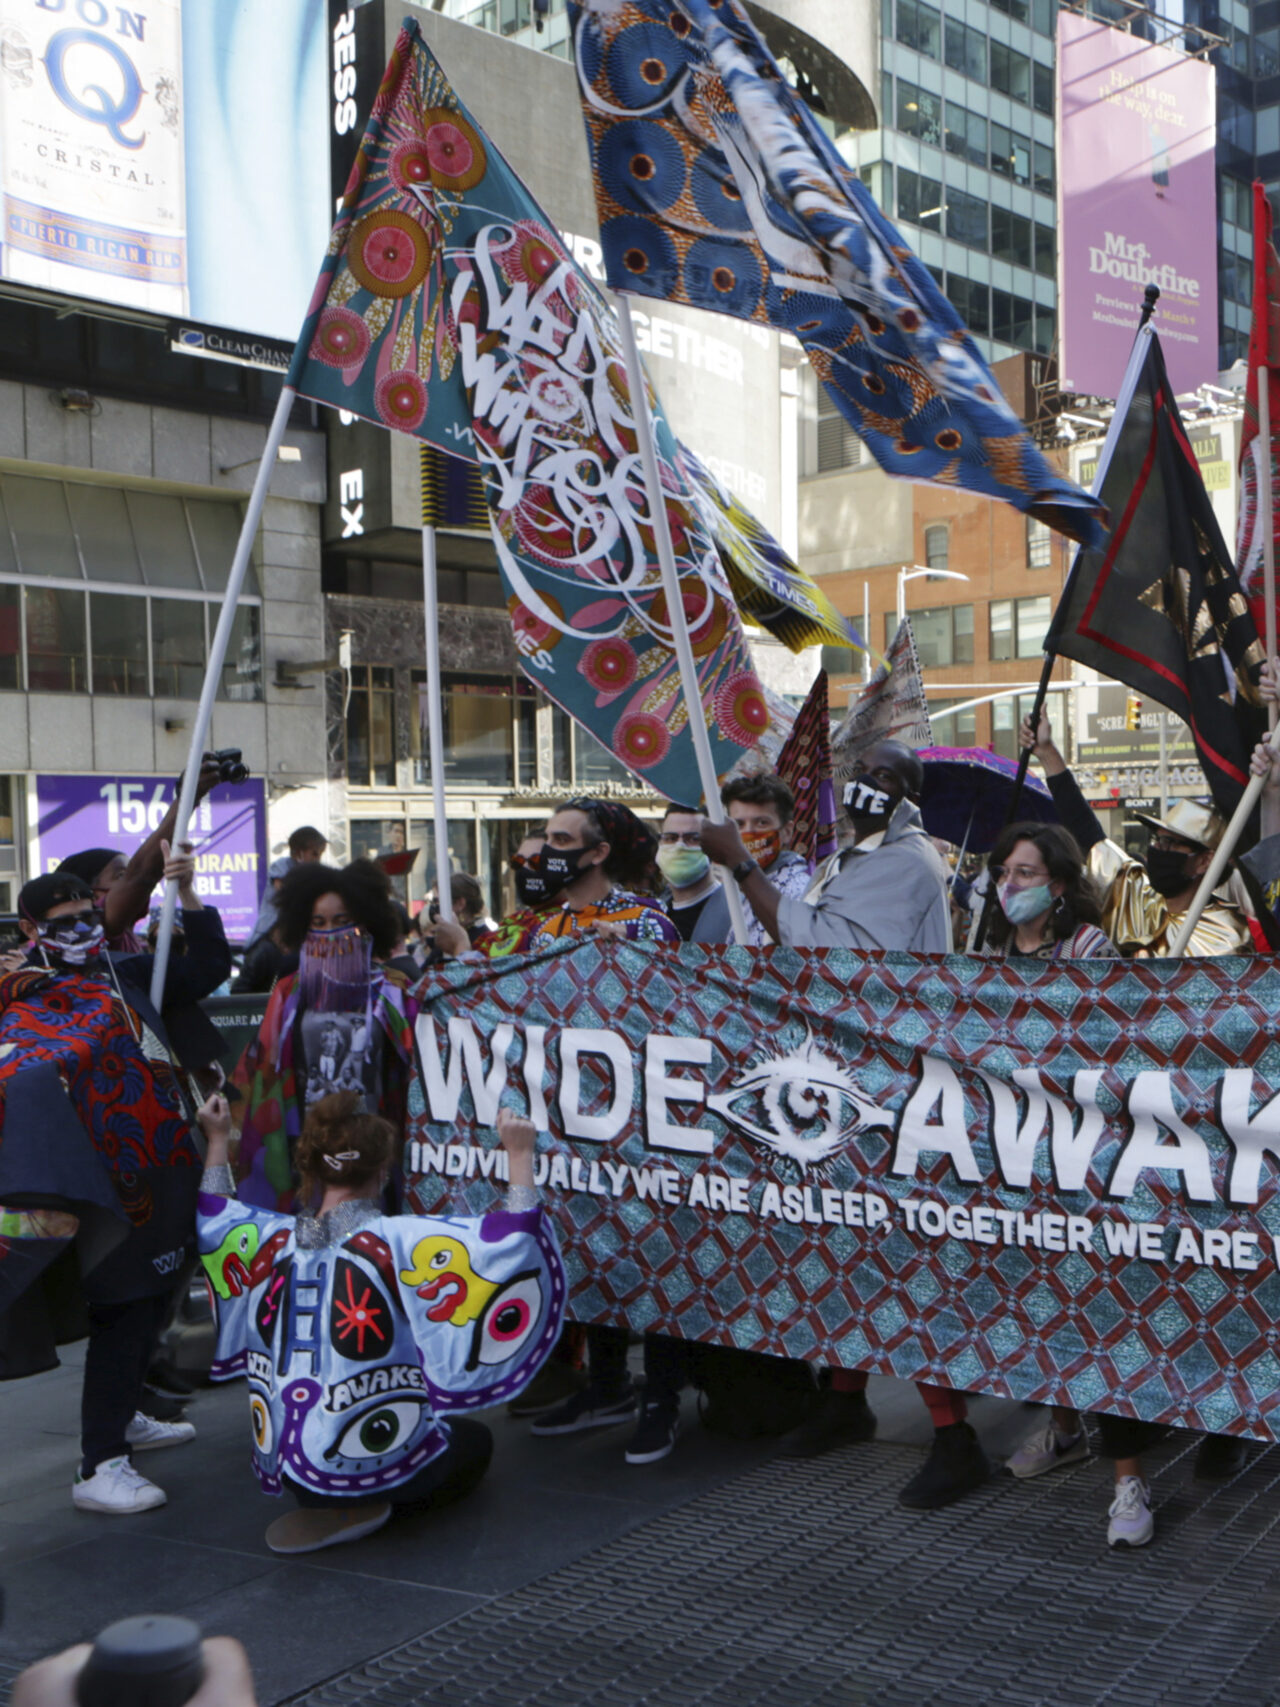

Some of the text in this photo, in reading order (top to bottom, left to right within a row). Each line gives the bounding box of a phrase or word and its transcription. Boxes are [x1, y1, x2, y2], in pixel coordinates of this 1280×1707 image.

[38, 27, 148, 151] Q
[1159, 91, 1177, 106] on
[1154, 104, 1188, 129] dear.
[36, 144, 154, 187] CRISTAL
[19, 217, 78, 249] PUERTO
[86, 235, 139, 263] RICAN
[1104, 231, 1151, 260] Mrs.
[1088, 247, 1200, 298] Doubtfire
[1125, 798, 1155, 808] SONY
[547, 858, 567, 866] VOTE
[547, 864, 569, 873] NOV 3
[526, 878, 543, 886] VOTE
[415, 1013, 714, 1155] WIDE
[411, 1142, 628, 1198] INDIVIUALLY
[630, 1165, 680, 1205] WE
[687, 1172, 750, 1215] ARE
[759, 1186, 893, 1234] ASLEEP,
[899, 1198, 1094, 1254] TOGETHER
[1103, 1221, 1165, 1263] WE
[1175, 1225, 1259, 1272] ARE
